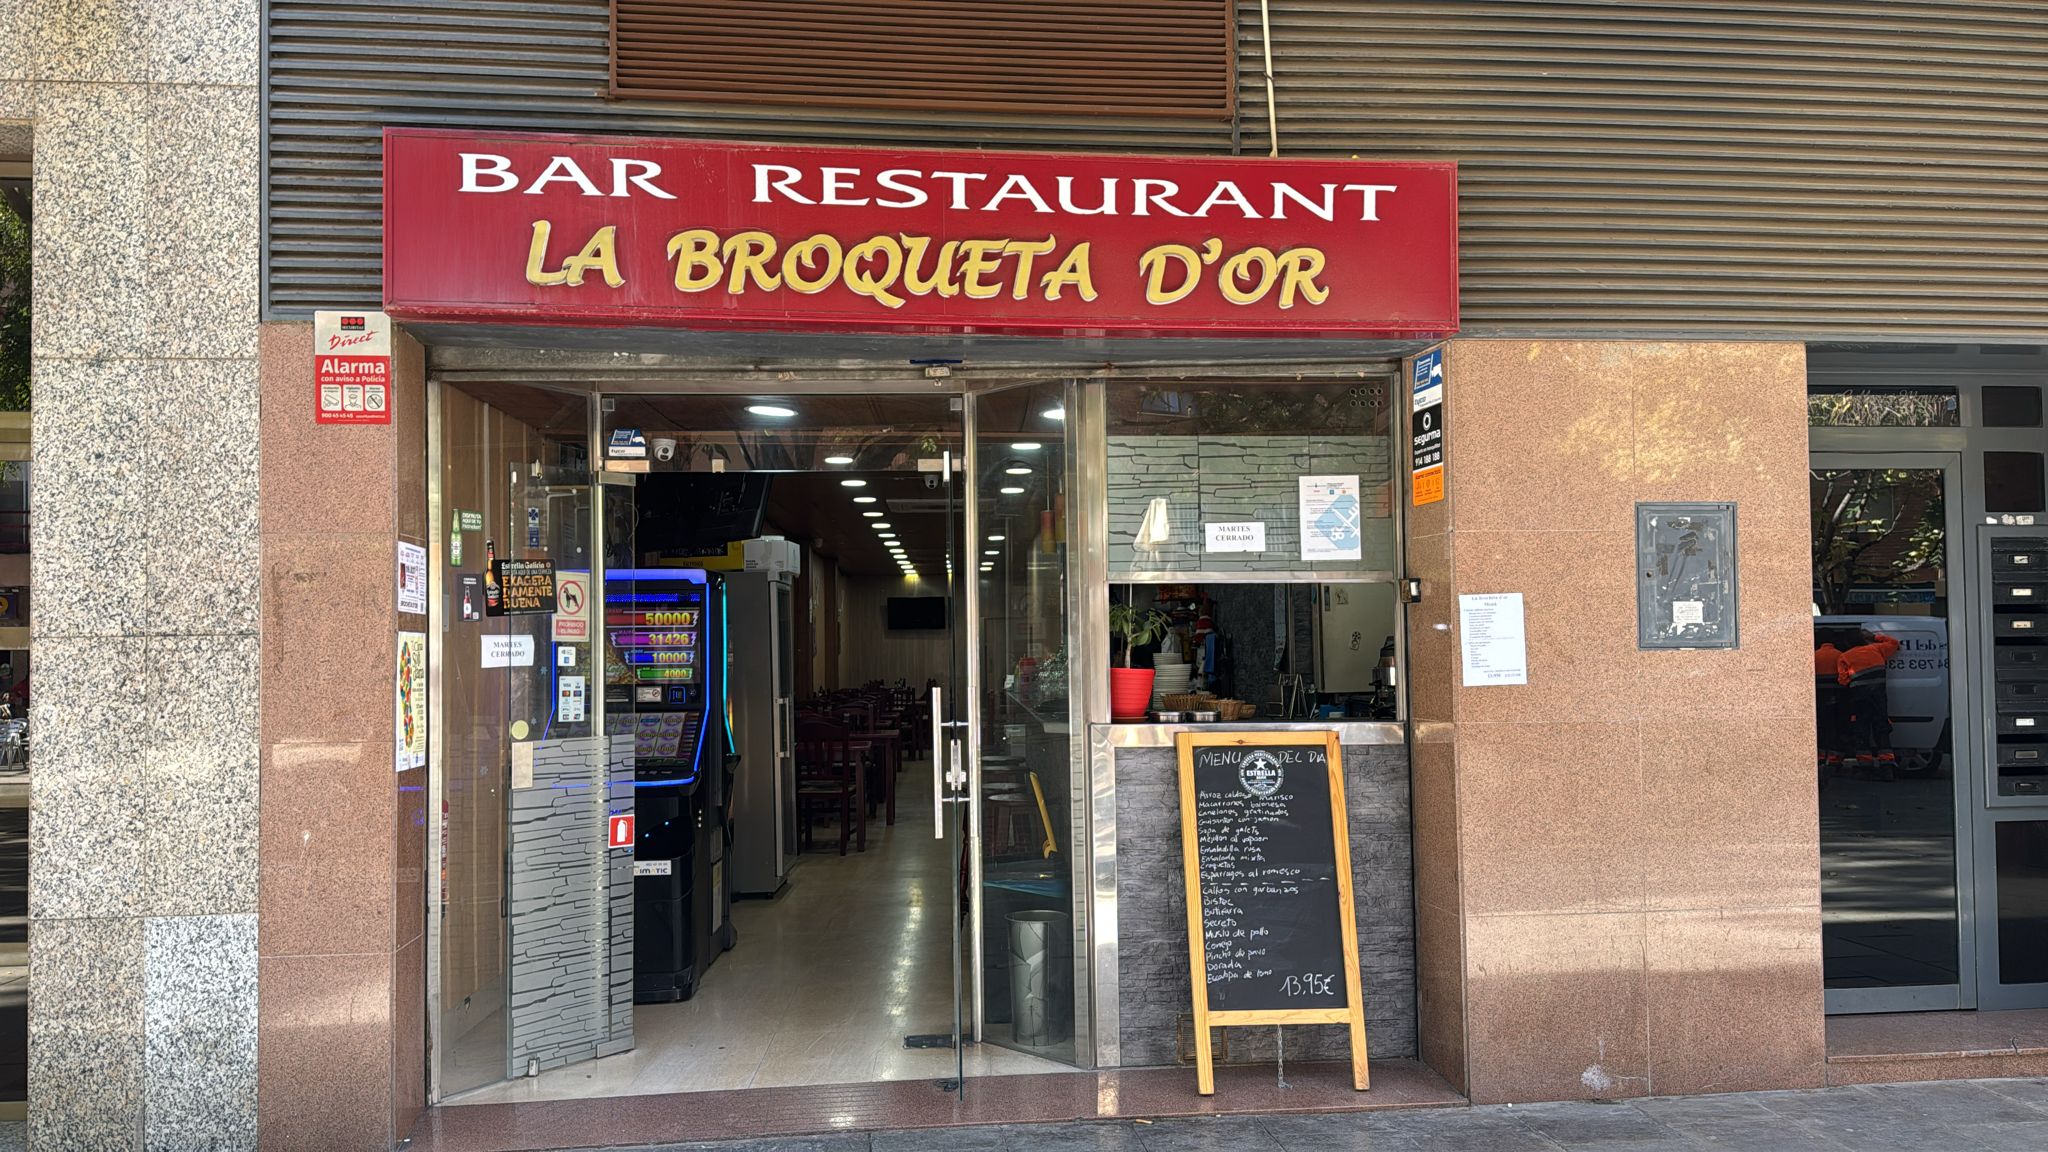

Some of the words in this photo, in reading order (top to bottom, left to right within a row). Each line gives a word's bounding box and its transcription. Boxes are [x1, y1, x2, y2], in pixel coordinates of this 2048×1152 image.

[458, 152, 678, 200] BAR
[751, 163, 1397, 222] RESTAURANT
[525, 219, 626, 289] LA
[667, 228, 1098, 310] BROQUETA
[1139, 237, 1329, 310] D'OR
[328, 330, 380, 350] Direct
[321, 358, 386, 374] Alarma
[361, 374, 386, 382] Policía
[1413, 429, 1441, 446] segurma
[501, 562, 524, 570] Estrella
[525, 561, 545, 569] Galicia
[645, 613, 691, 626] 50000
[648, 633, 689, 645] 31426
[493, 641, 523, 649] MARTES
[490, 650, 526, 658] CERRADO
[652, 653, 687, 663] 10000
[663, 670, 687, 678] 4000
[1199, 751, 1242, 768] MENU
[1277, 751, 1303, 765] DEL
[1308, 750, 1328, 765] DIA
[1221, 826, 1230, 834] de
[1230, 834, 1239, 843] al
[1247, 868, 1259, 877] al
[1262, 868, 1301, 877] romesco
[1204, 918, 1238, 929] Secreto
[1232, 928, 1247, 938] de
[1250, 926, 1270, 942] pollo
[1205, 940, 1233, 951] Conejo
[1234, 947, 1246, 958] de
[1206, 958, 1243, 972] Dorada
[1243, 969, 1253, 979] de
[1279, 972, 1336, 997] 13,95€
